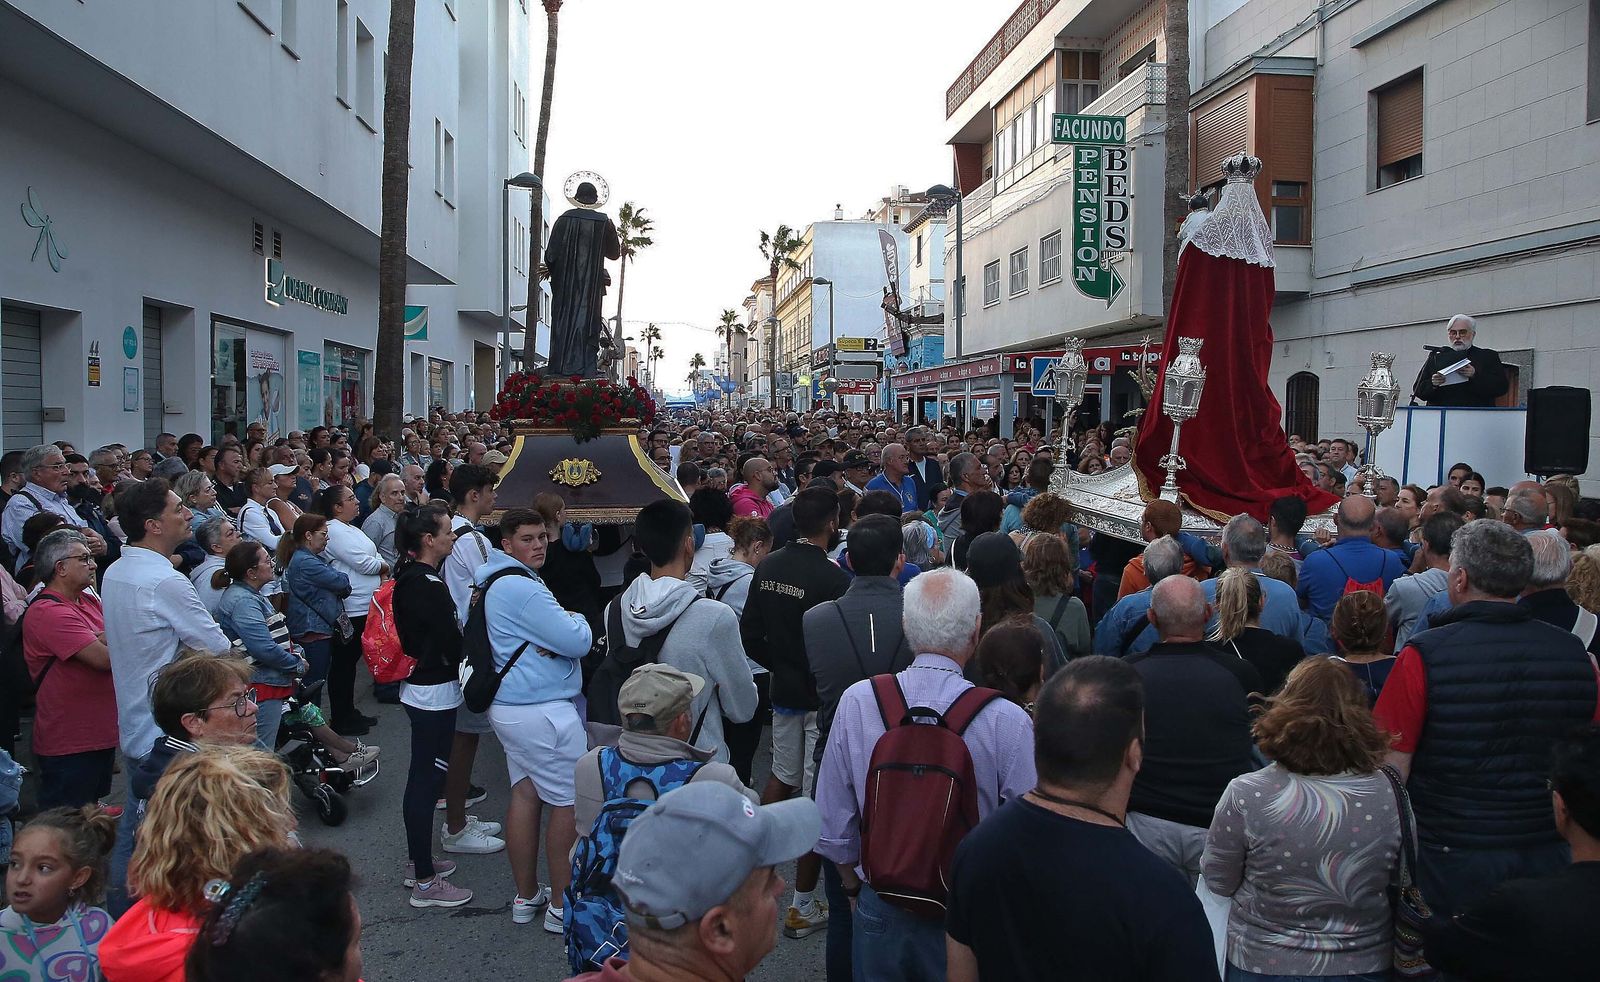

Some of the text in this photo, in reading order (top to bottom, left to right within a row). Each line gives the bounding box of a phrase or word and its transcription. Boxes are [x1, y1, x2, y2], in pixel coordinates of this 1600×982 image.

[1054, 118, 1124, 141] FACUNDO
[1103, 148, 1129, 249] BEDS
[1076, 149, 1100, 282] PENSION
[1015, 358, 1027, 369] la
[1121, 352, 1130, 361] la
[760, 580, 805, 599] SAN ISIDRO
